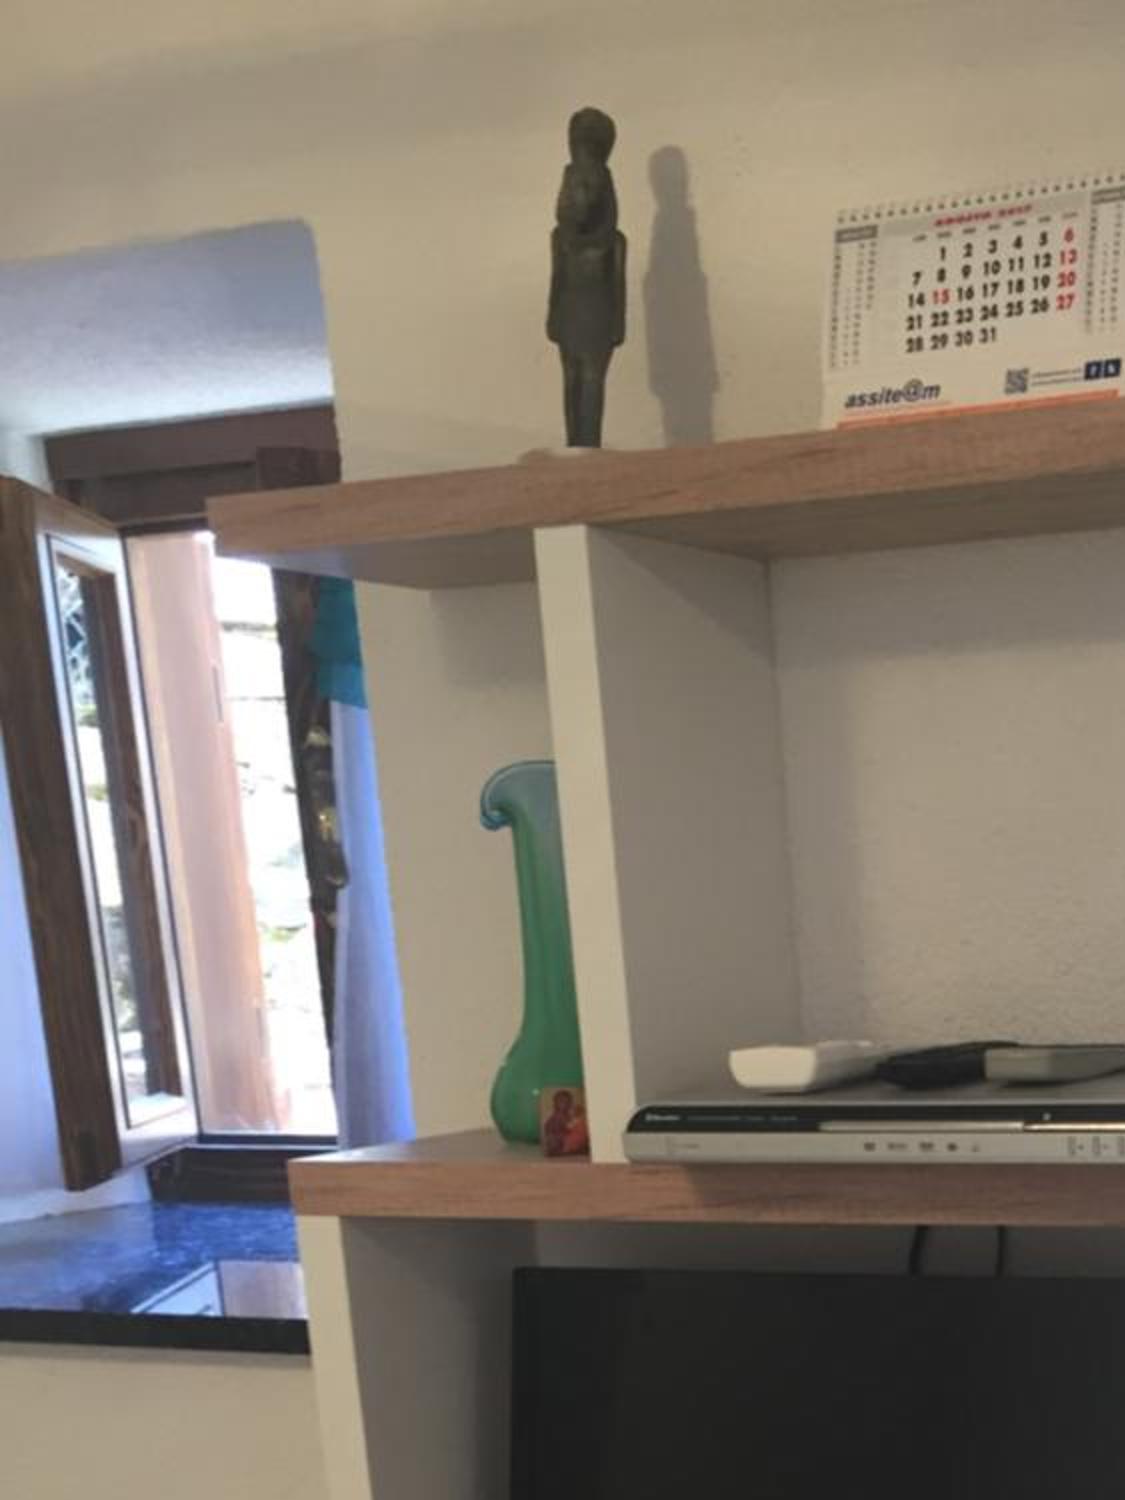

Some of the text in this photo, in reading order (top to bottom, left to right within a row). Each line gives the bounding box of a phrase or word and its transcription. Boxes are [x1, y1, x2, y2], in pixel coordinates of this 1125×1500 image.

[983, 260, 1001, 276] 10
[1008, 256, 1024, 272] 11
[1034, 252, 1052, 269] 12
[1060, 249, 1077, 265] 13
[908, 271, 1076, 308] 14 15 16 17 18 19 20
[906, 293, 1075, 331] 21 22 23 24 25 26 27
[906, 326, 996, 353] 28 29 30 31
[844, 379, 941, 408] assite@m
